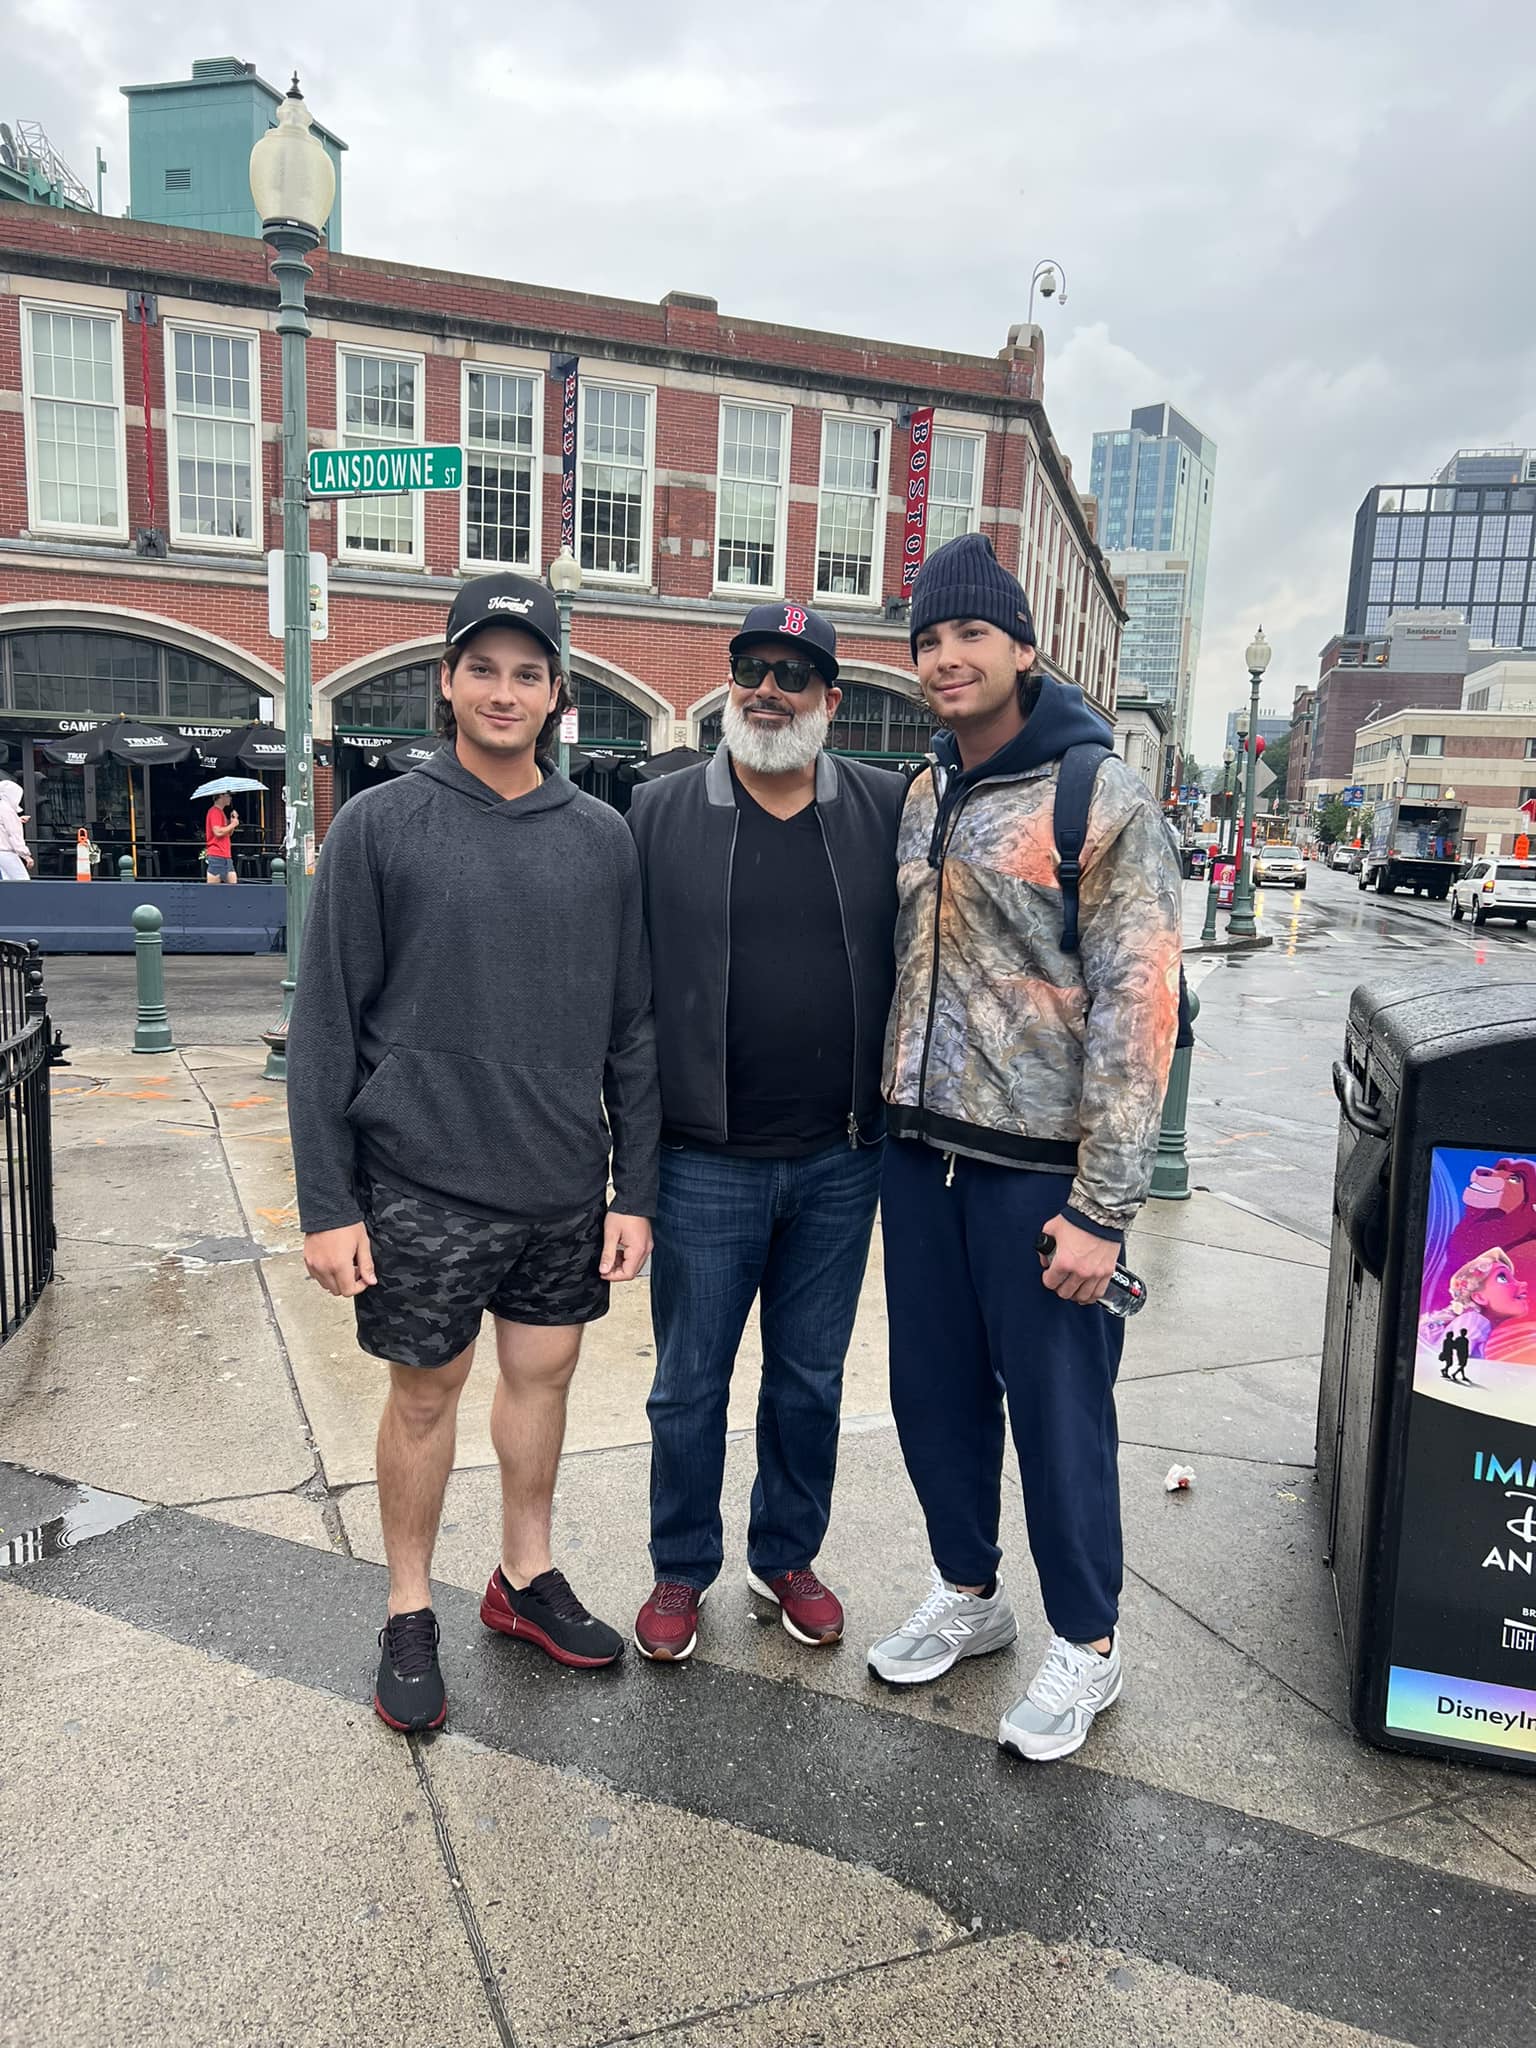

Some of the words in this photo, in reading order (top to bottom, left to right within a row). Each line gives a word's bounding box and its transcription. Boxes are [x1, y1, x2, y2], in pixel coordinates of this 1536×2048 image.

[314, 452, 434, 489] LANSDOWNE
[444, 467, 456, 485] ST
[903, 419, 930, 585] BOSTON
[779, 604, 808, 635] B
[59, 720, 98, 732] GAME
[123, 736, 164, 747] TRULY
[407, 748, 435, 759] TRU
